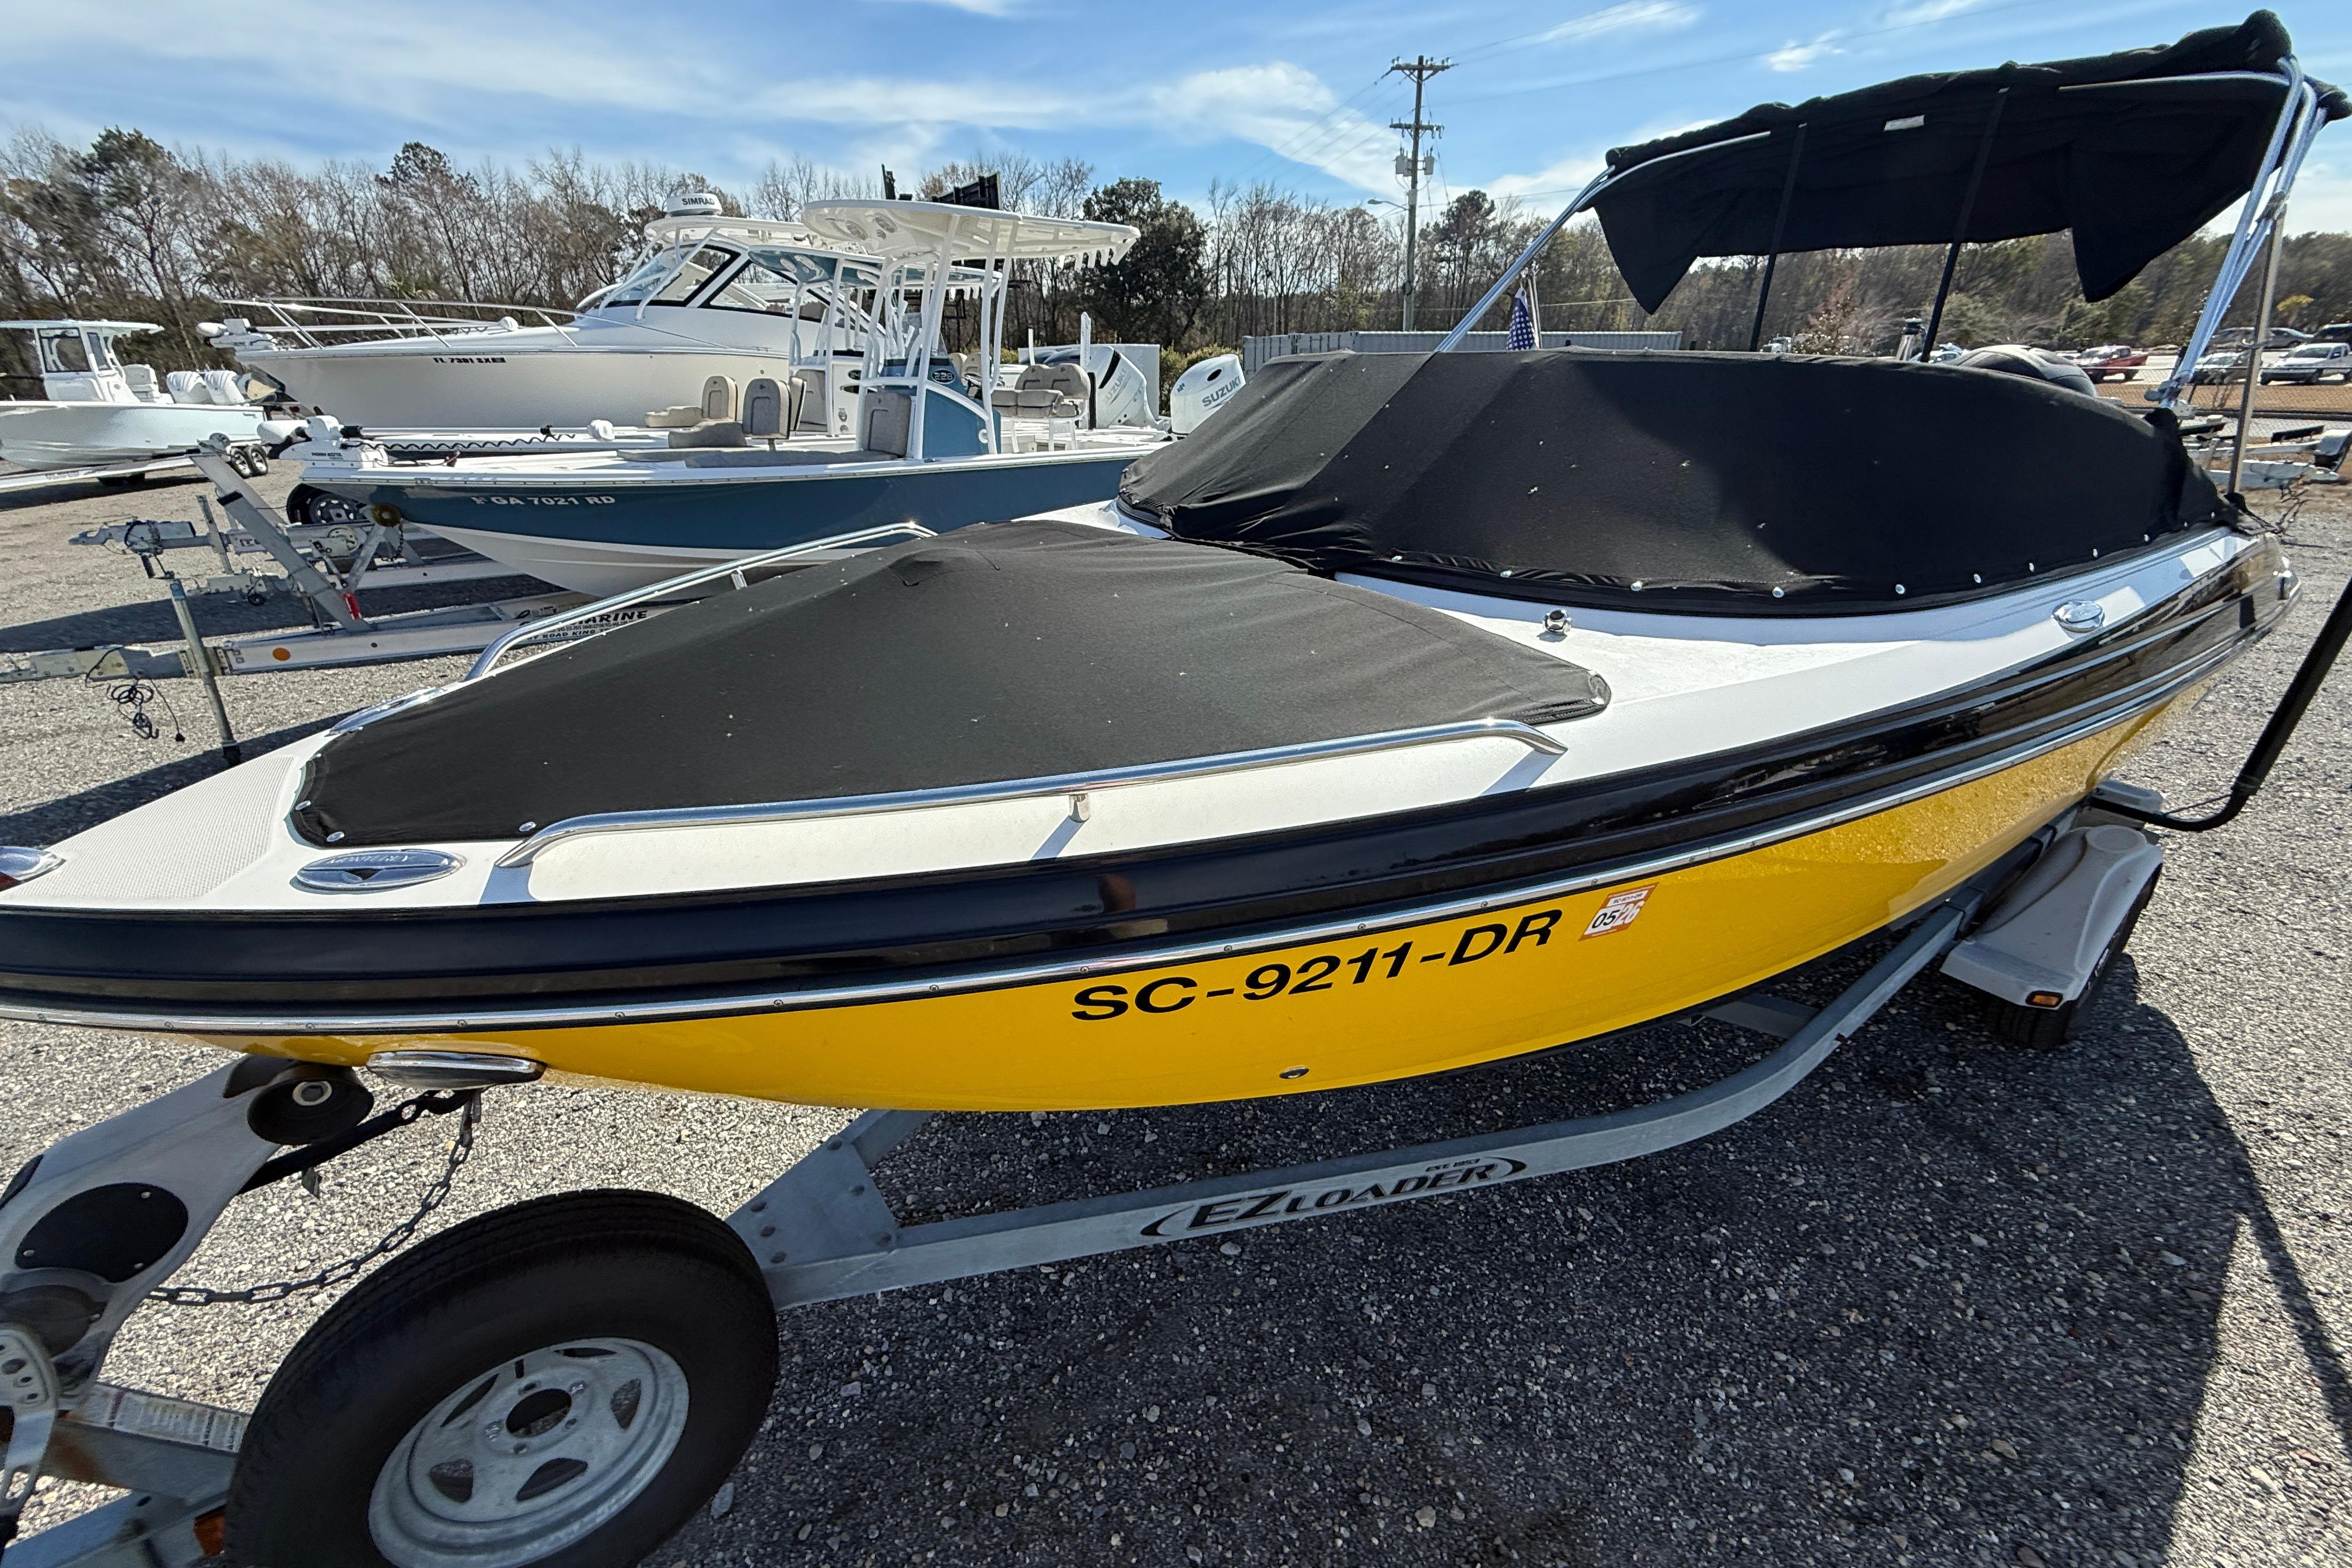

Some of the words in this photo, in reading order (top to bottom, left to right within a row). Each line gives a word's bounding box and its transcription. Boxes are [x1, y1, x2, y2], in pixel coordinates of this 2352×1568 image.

[682, 197, 715, 206] SIMRAD
[933, 372, 954, 380] 228
[1201, 375, 1241, 407] SUZUKI
[491, 496, 525, 505] GA
[527, 496, 579, 505] 7021
[584, 496, 616, 505] RD
[1072, 909, 1563, 1021] SC-9211-DR
